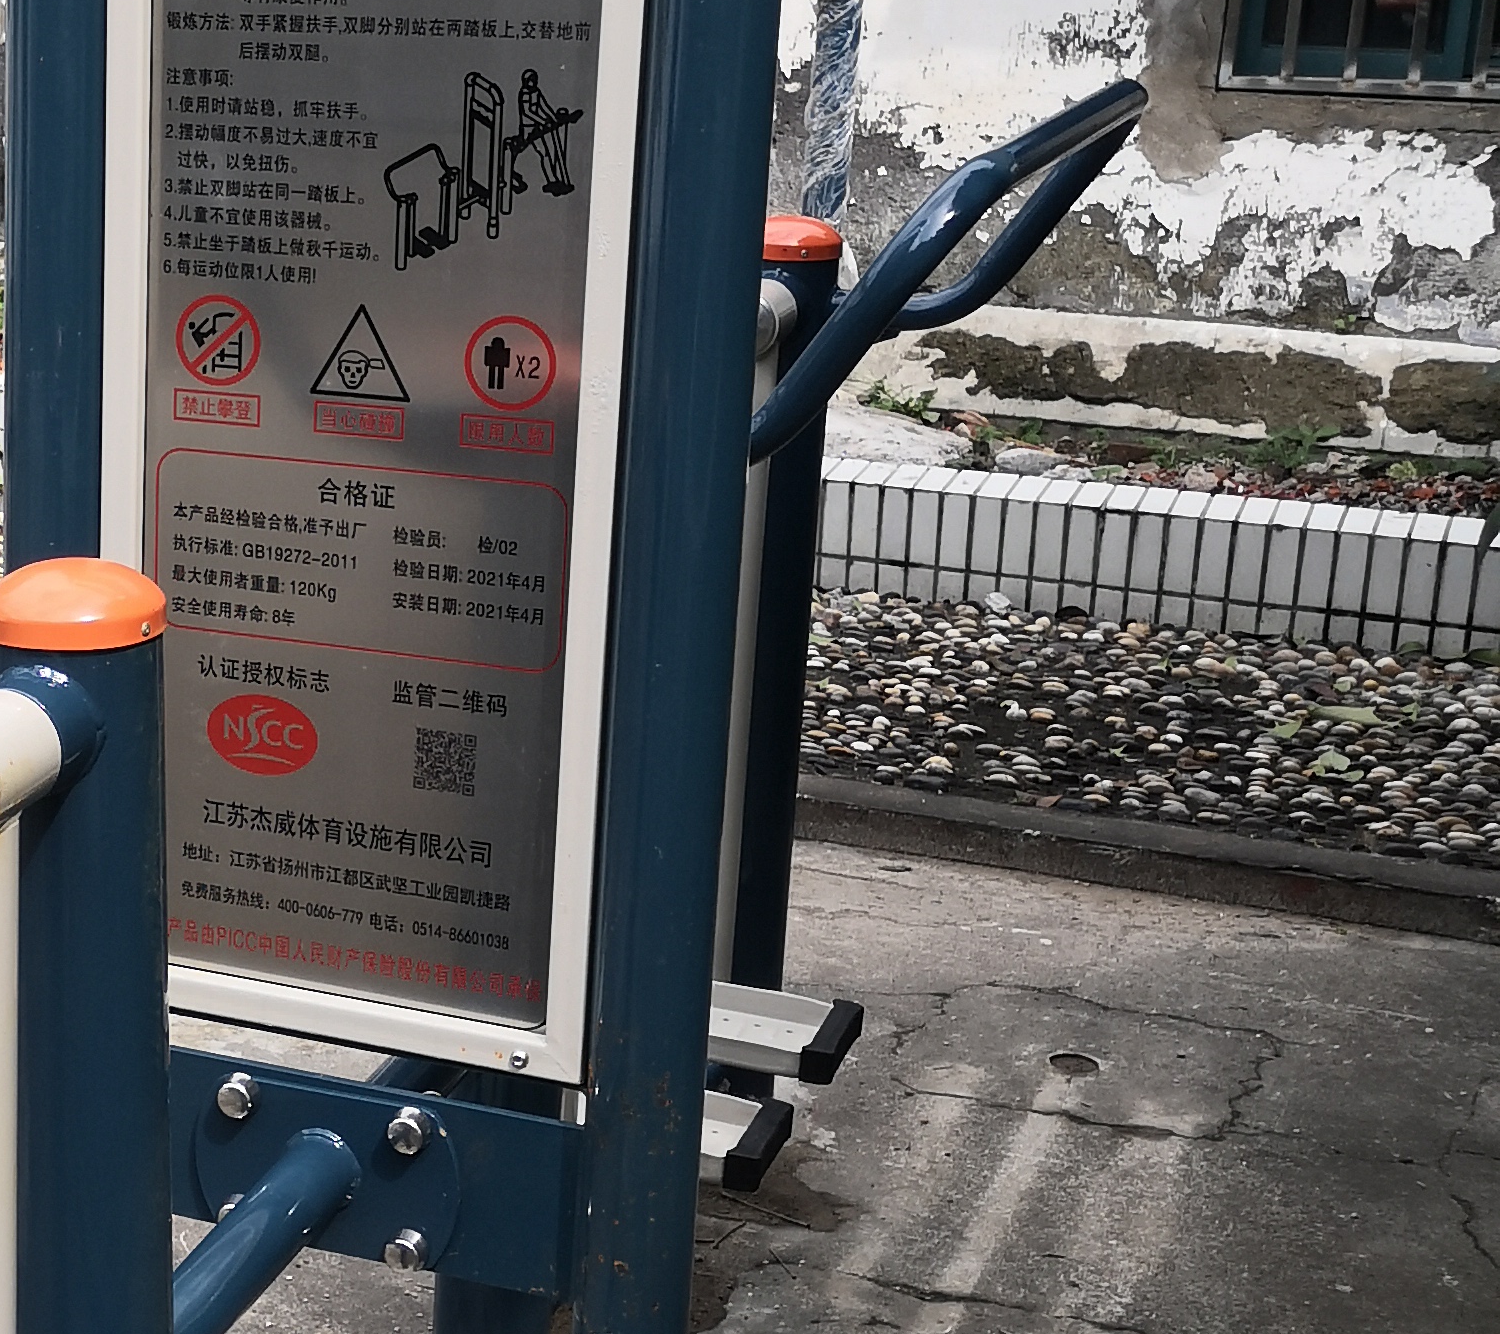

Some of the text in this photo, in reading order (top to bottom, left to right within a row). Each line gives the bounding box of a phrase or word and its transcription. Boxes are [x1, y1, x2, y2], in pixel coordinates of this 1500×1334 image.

[238, 42, 329, 64] 后摆动双腿。
[165, 68, 234, 87] 注意事项:
[164, 178, 365, 205] 3.禁止双脚站在同一踏板上。
[163, 205, 331, 232] 4.儿童不宜使用该器械。
[180, 394, 253, 422] 禁止攀登
[320, 407, 396, 435] 当心碰撞
[467, 421, 546, 449] 限用人数
[316, 477, 396, 510] 合格证
[197, 654, 331, 694] 认证授权标志
[391, 679, 509, 719] 监管二维码
[202, 798, 493, 870] 江苏杰威体育设施有限公司
